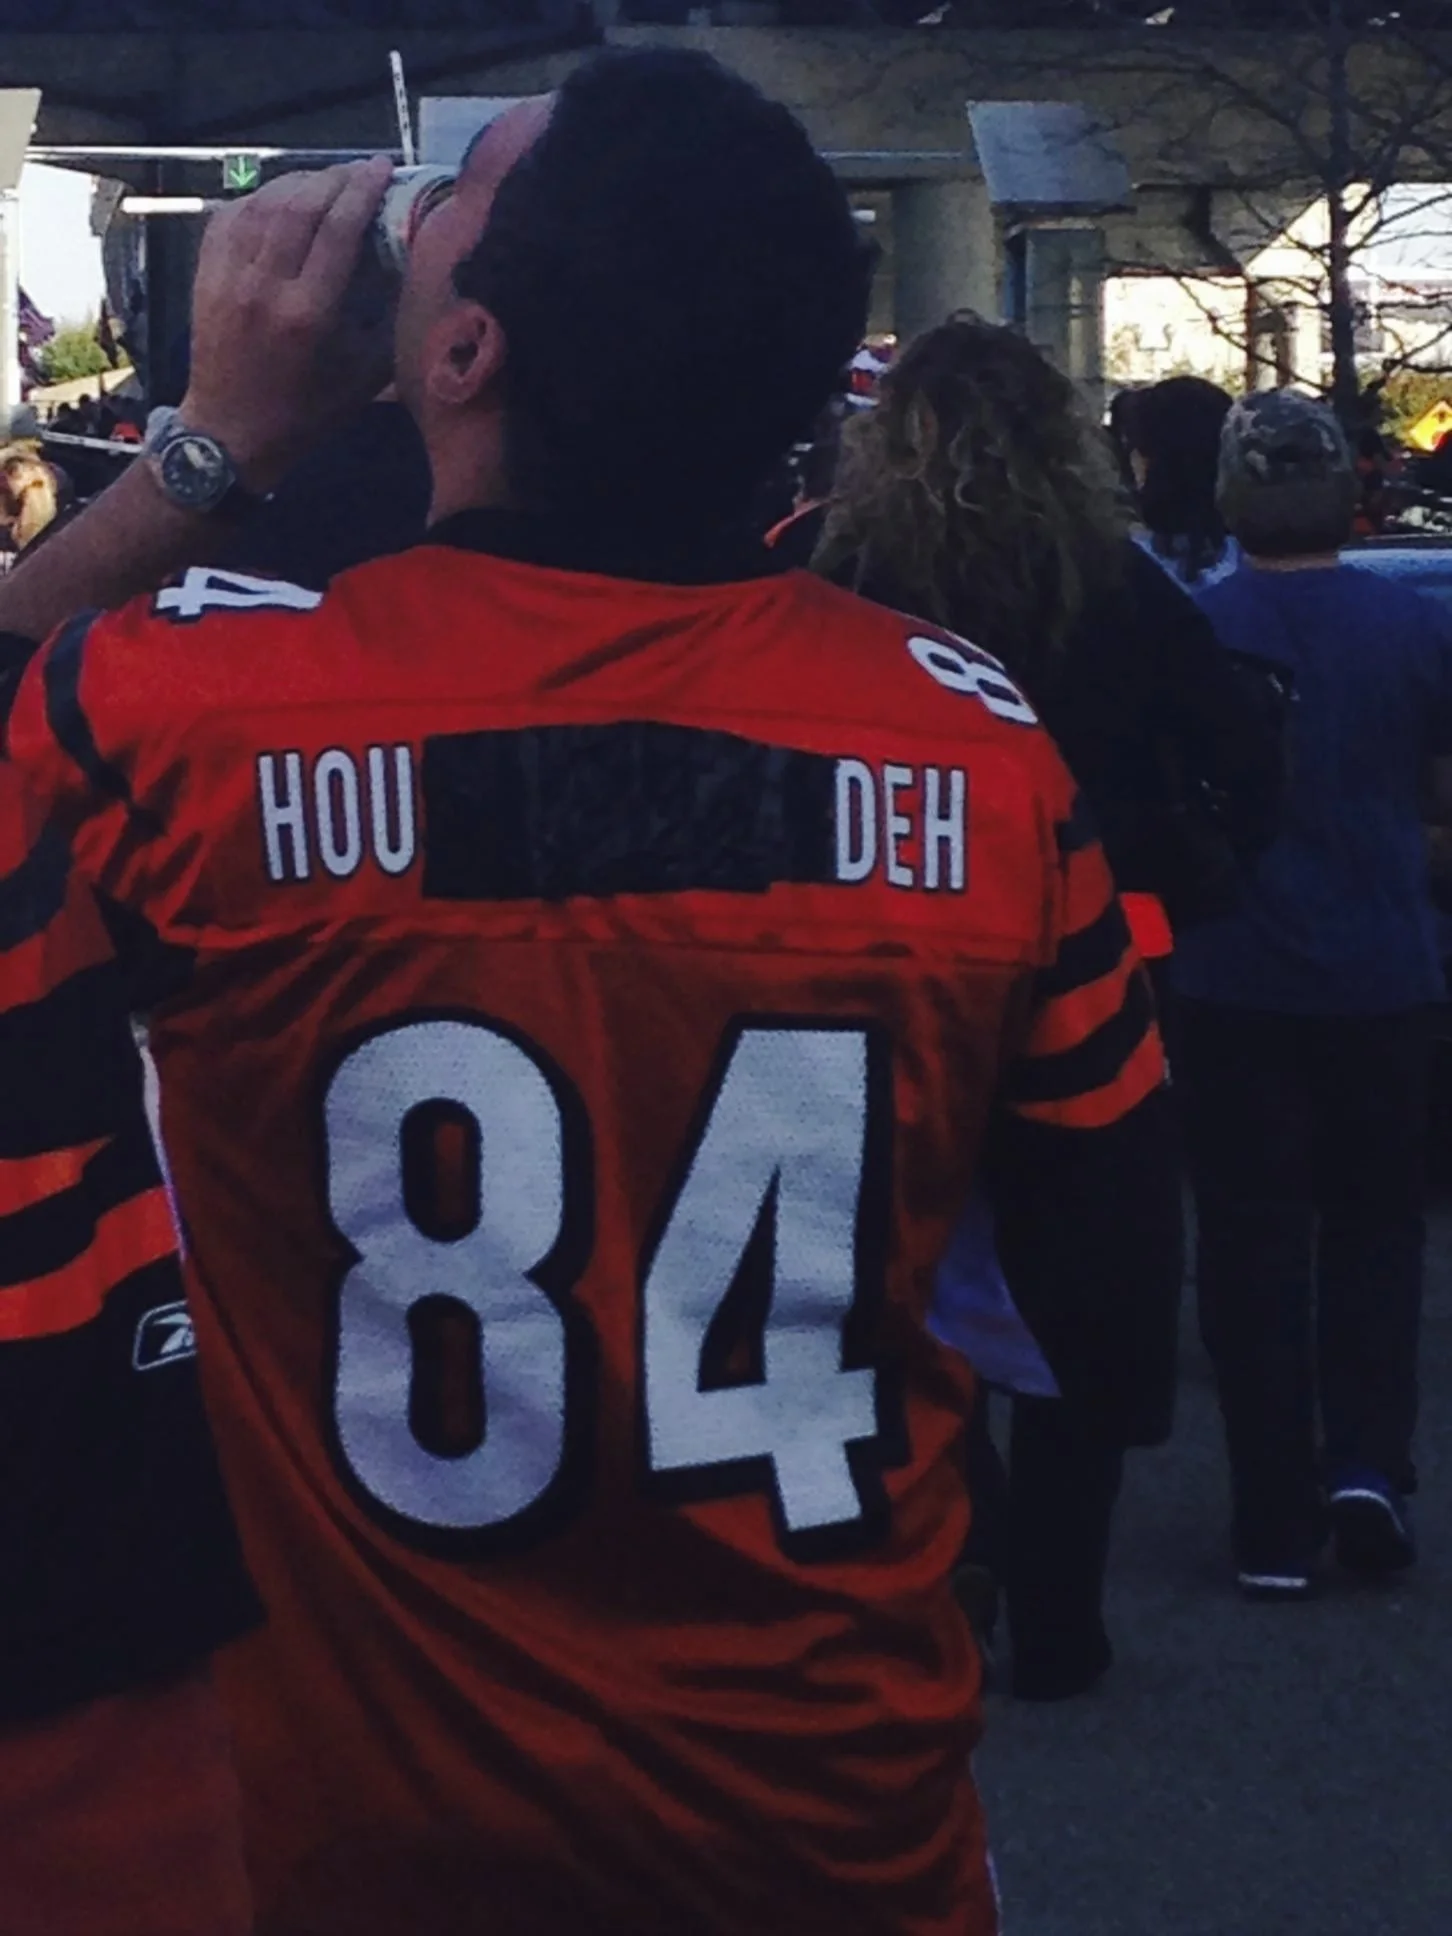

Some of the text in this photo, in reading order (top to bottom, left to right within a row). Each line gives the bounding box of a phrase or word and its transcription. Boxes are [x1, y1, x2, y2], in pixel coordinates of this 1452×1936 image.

[155, 566, 324, 617] 4
[257, 745, 966, 891] HOU DEH
[323, 1016, 880, 1534] 84
